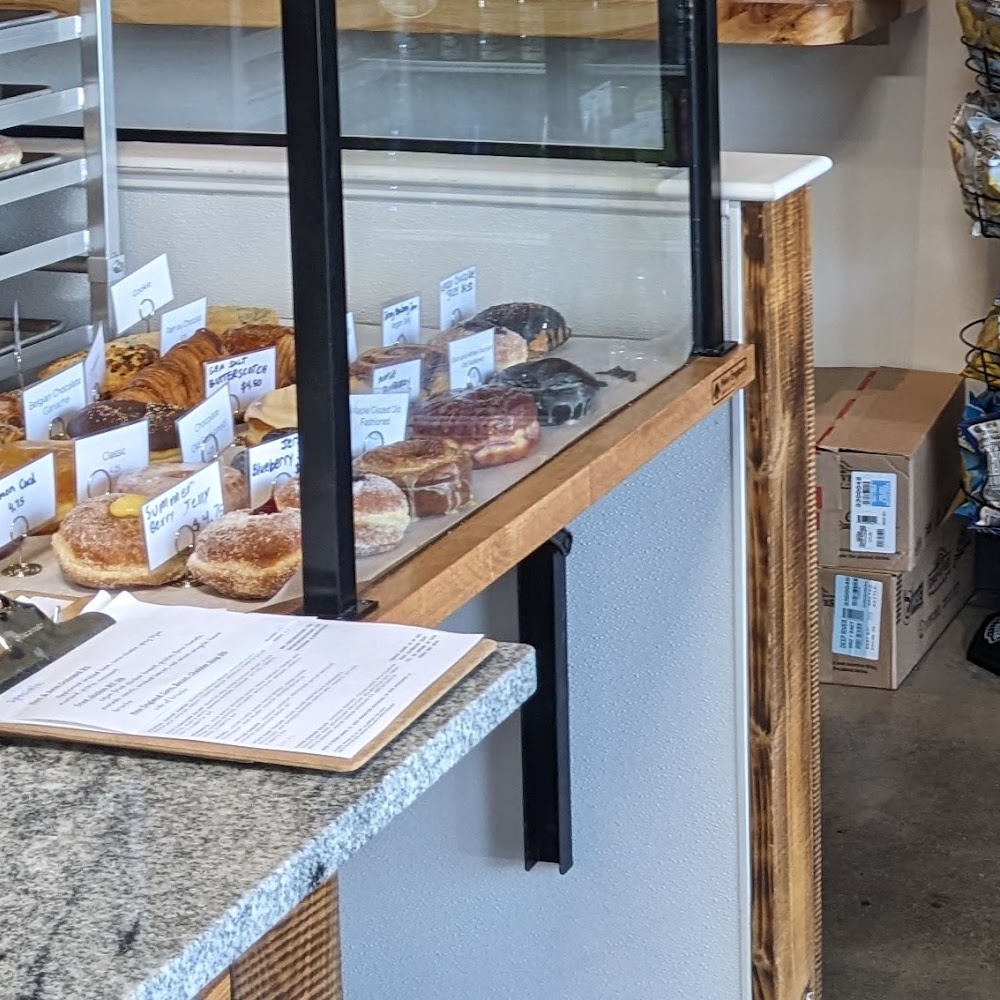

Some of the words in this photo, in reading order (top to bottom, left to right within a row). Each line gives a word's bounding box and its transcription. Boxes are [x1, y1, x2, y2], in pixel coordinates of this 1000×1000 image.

[209, 363, 225, 375] SEA
[209, 364, 268, 388] BUTTERSCOTCH
[252, 453, 294, 477] Blueberry
